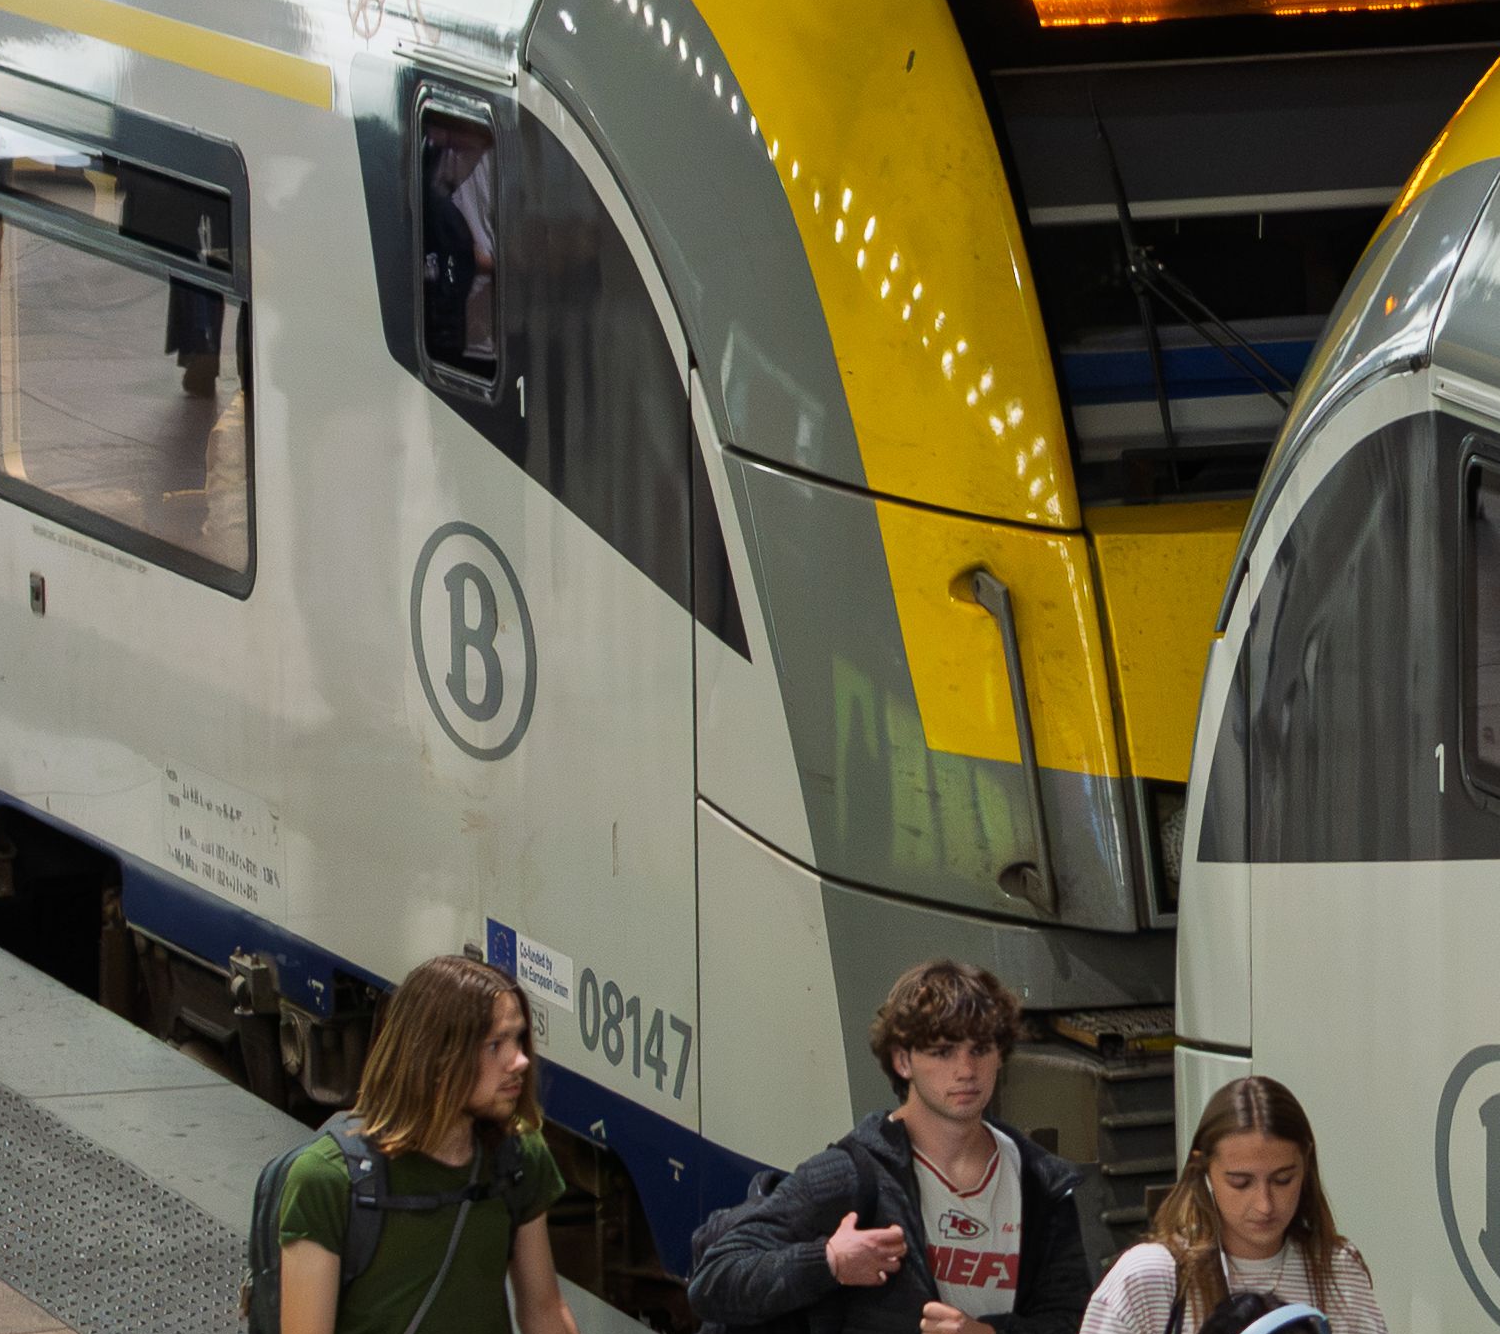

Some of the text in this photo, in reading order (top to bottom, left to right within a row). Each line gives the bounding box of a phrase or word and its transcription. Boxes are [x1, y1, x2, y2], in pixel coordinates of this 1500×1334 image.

[444, 562, 503, 722] B
[519, 941, 547, 971] Co-funded
[528, 968, 553, 992] European
[578, 967, 693, 1101] 08147
